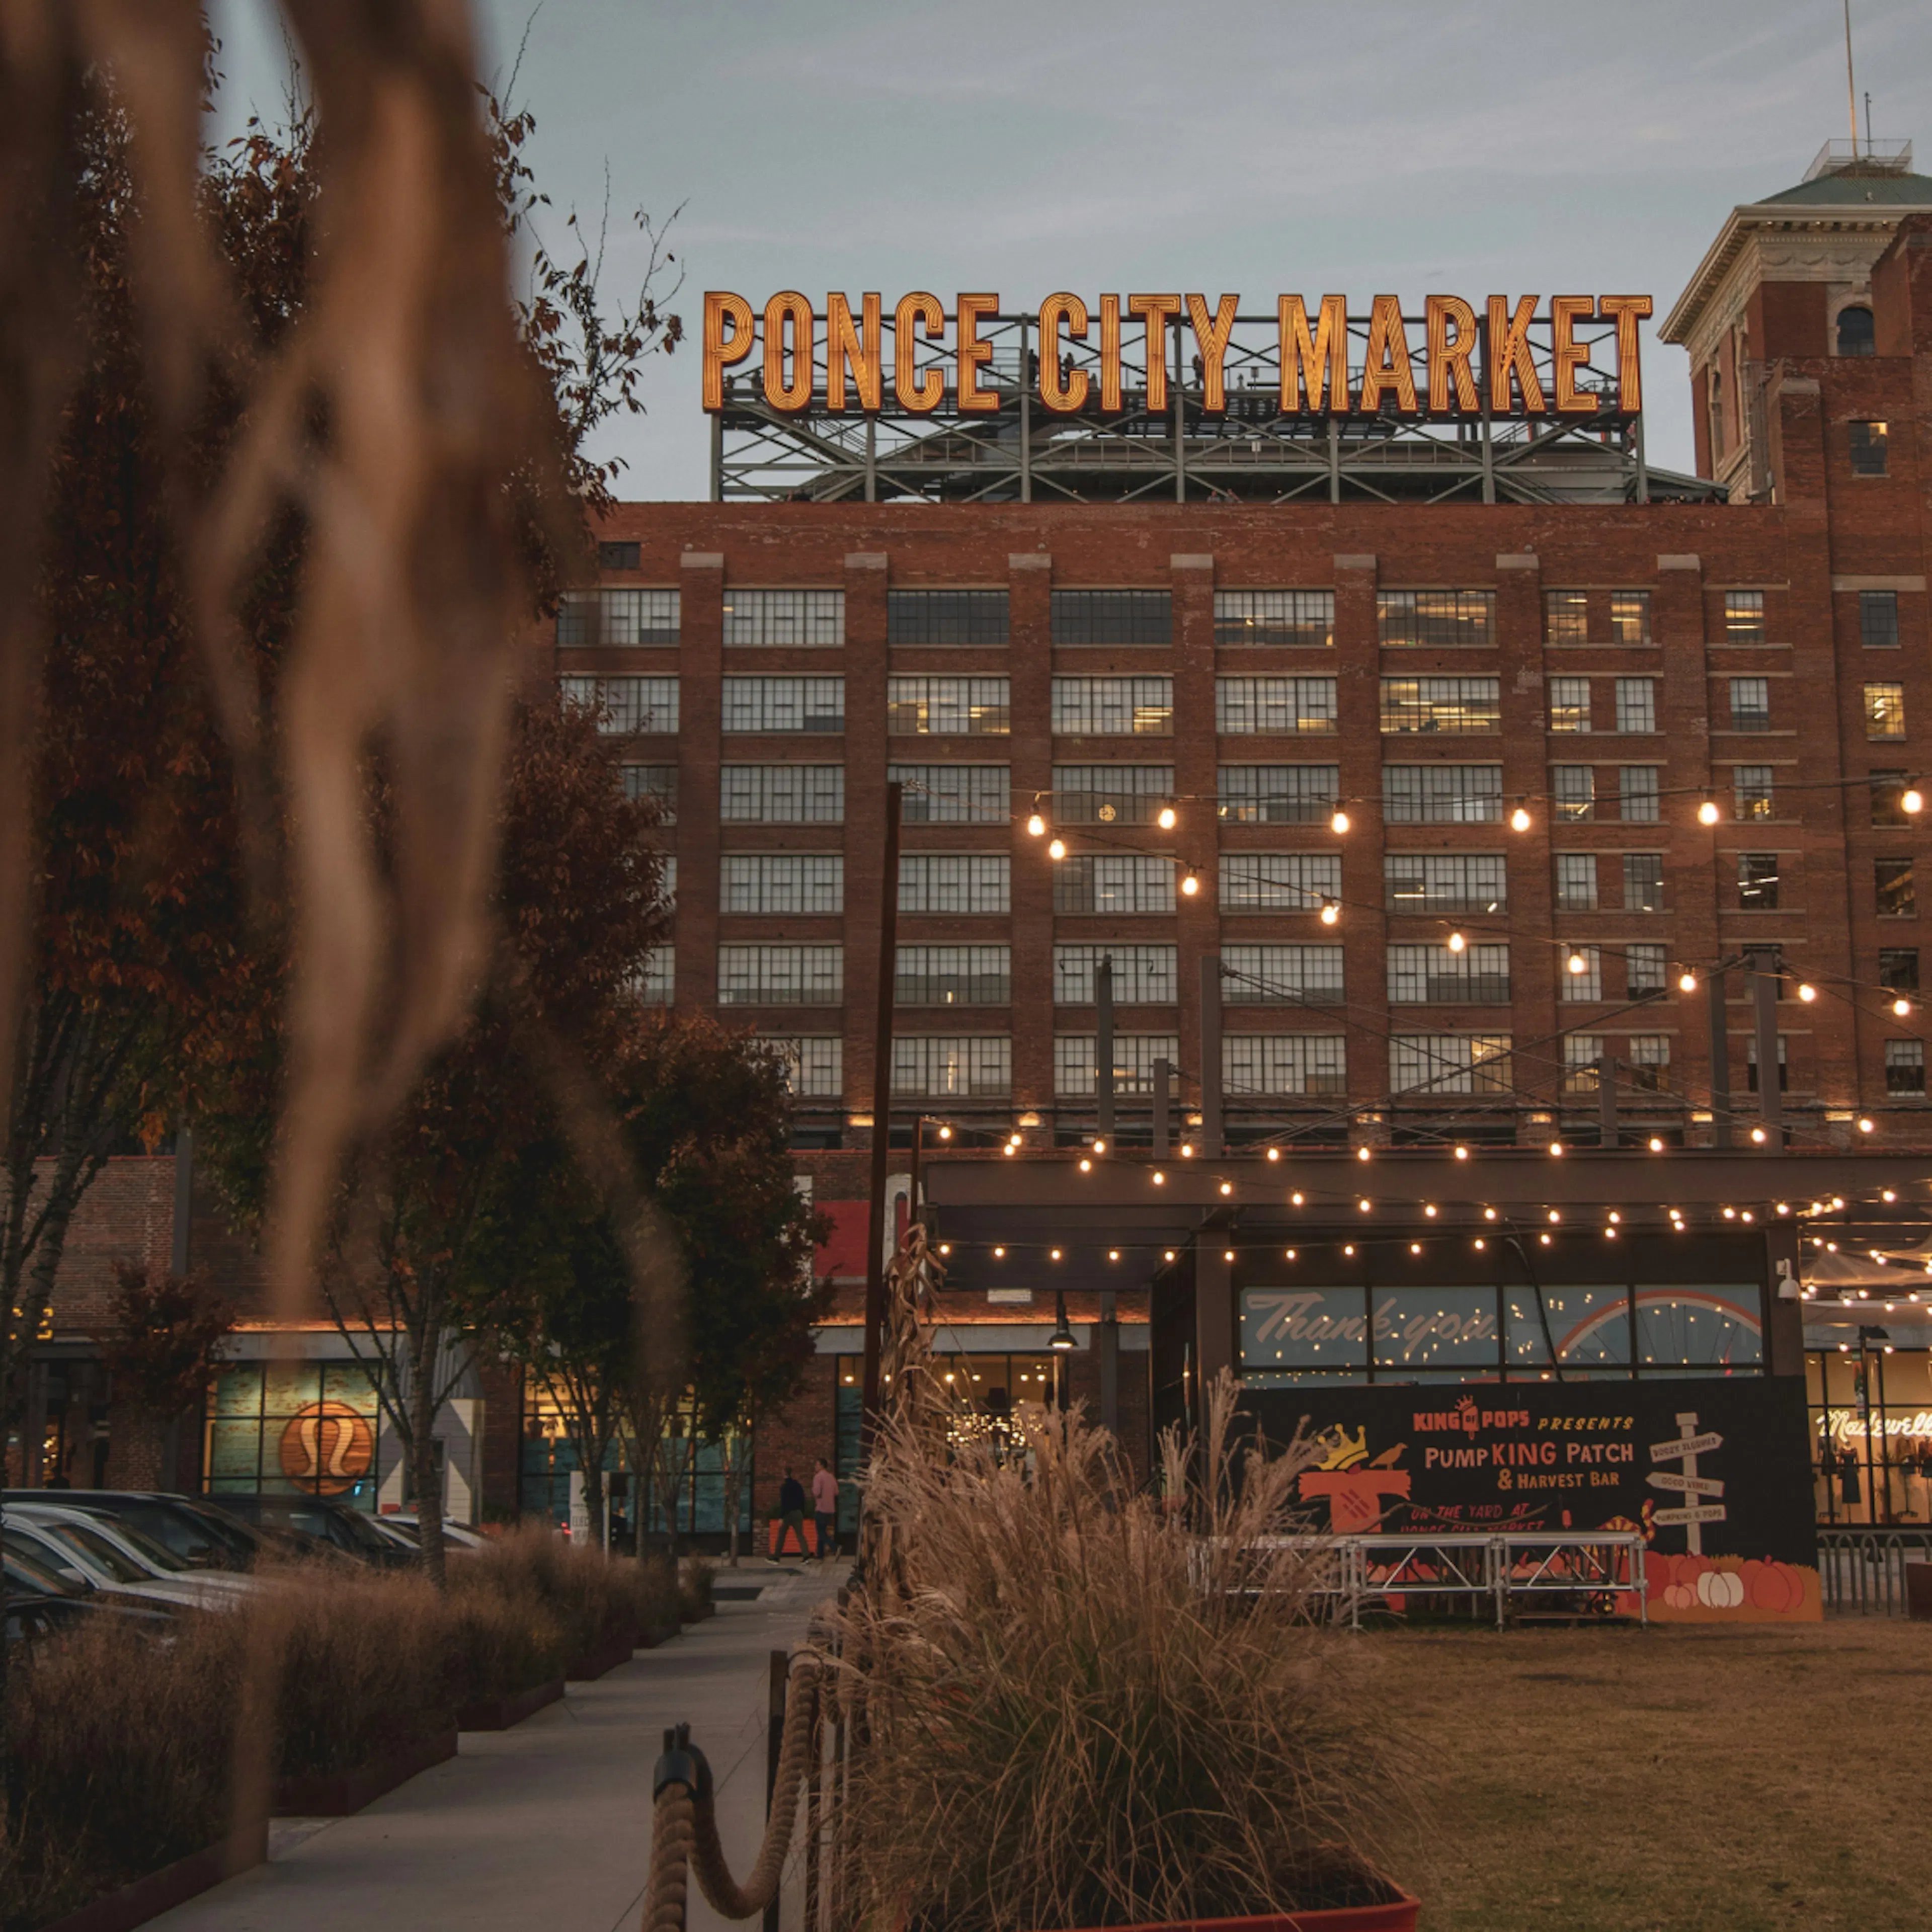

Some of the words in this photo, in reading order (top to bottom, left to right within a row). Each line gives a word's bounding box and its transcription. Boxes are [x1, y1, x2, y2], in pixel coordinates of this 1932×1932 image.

[703, 291, 1001, 414] PONCE
[1038, 292, 1240, 413] CITY
[1278, 294, 1653, 414] MARKET
[1247, 1292, 1397, 1343] Thank
[1404, 1313, 1495, 1361] you
[1413, 1412, 1460, 1431] KING
[1482, 1410, 1530, 1428] POPS
[1538, 1416, 1635, 1430] PRESENTS
[1566, 1441, 1635, 1464] PATCH
[1497, 1468, 1512, 1491] &
[1517, 1473, 1584, 1489] HARVEST
[1590, 1470, 1620, 1488] BAR
[1436, 1505, 1464, 1519] THE
[1468, 1504, 1503, 1518] YARD
[1510, 1502, 1531, 1517] AT
